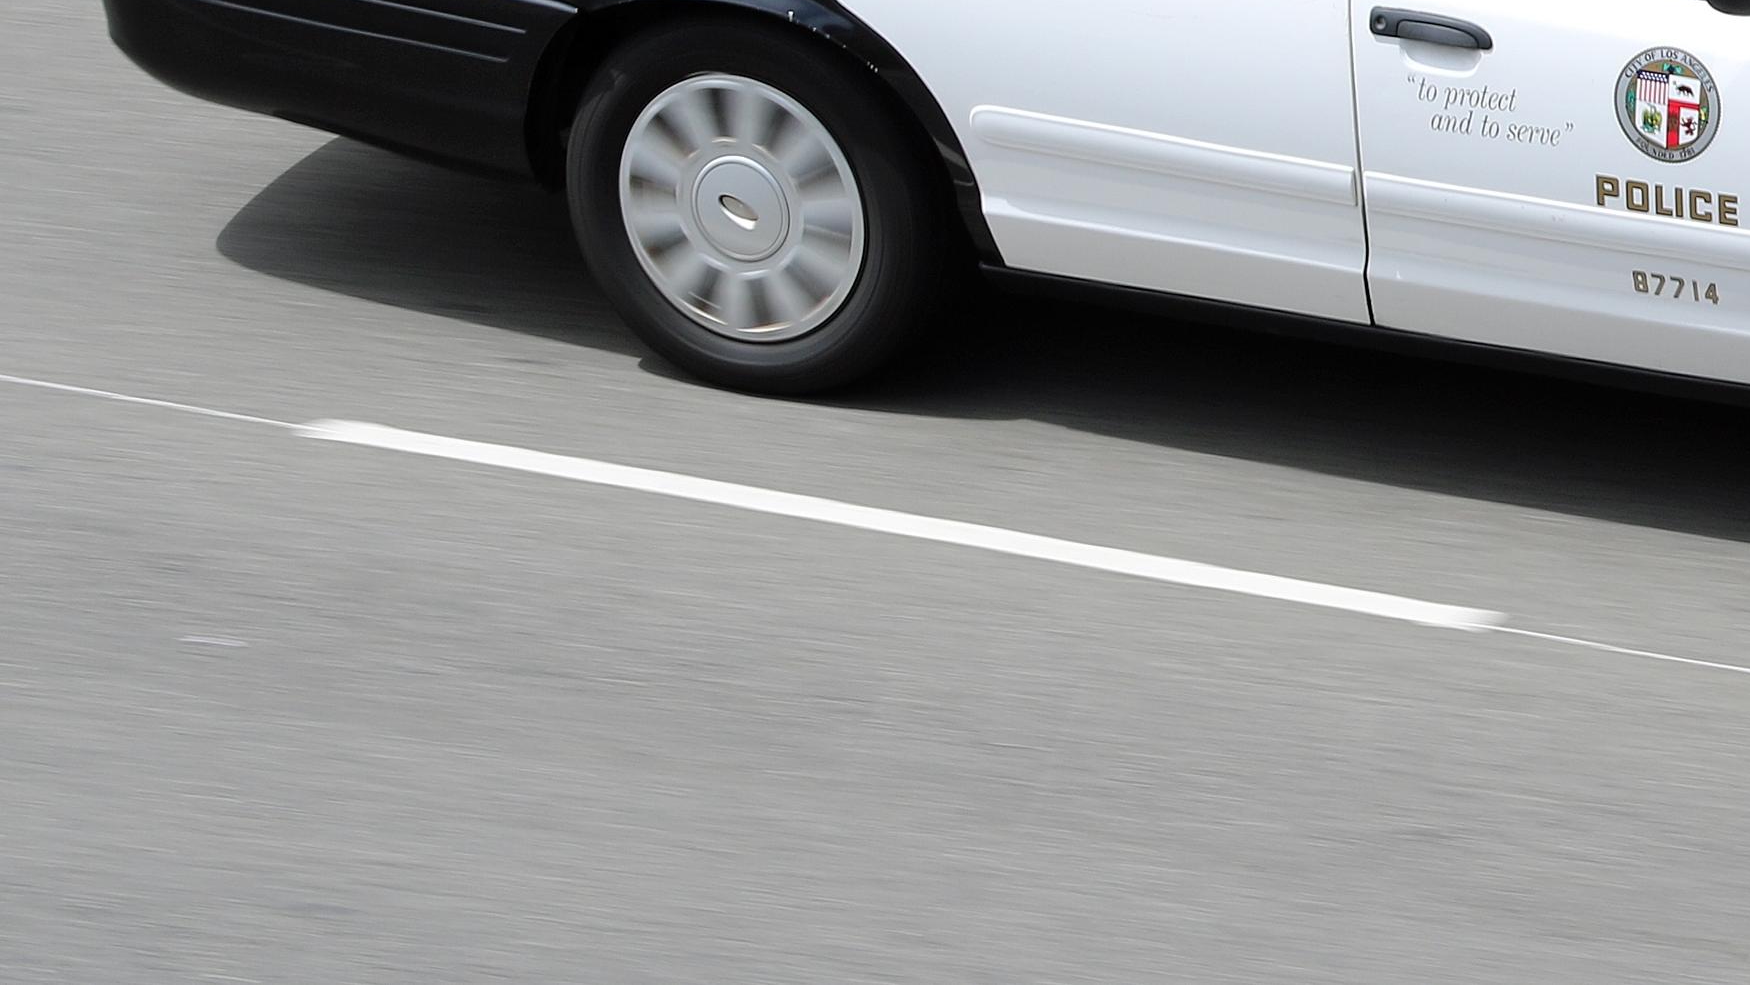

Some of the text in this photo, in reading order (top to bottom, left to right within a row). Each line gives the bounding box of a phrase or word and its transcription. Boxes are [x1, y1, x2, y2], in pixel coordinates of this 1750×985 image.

[1624, 50, 1714, 93] CITY OF LOS ANGELES
[1444, 85, 1517, 112] protect
[1431, 110, 1474, 136] and
[1481, 114, 1500, 139] to
[1595, 174, 1739, 226] POLICE
[1632, 270, 1720, 305] 87714
